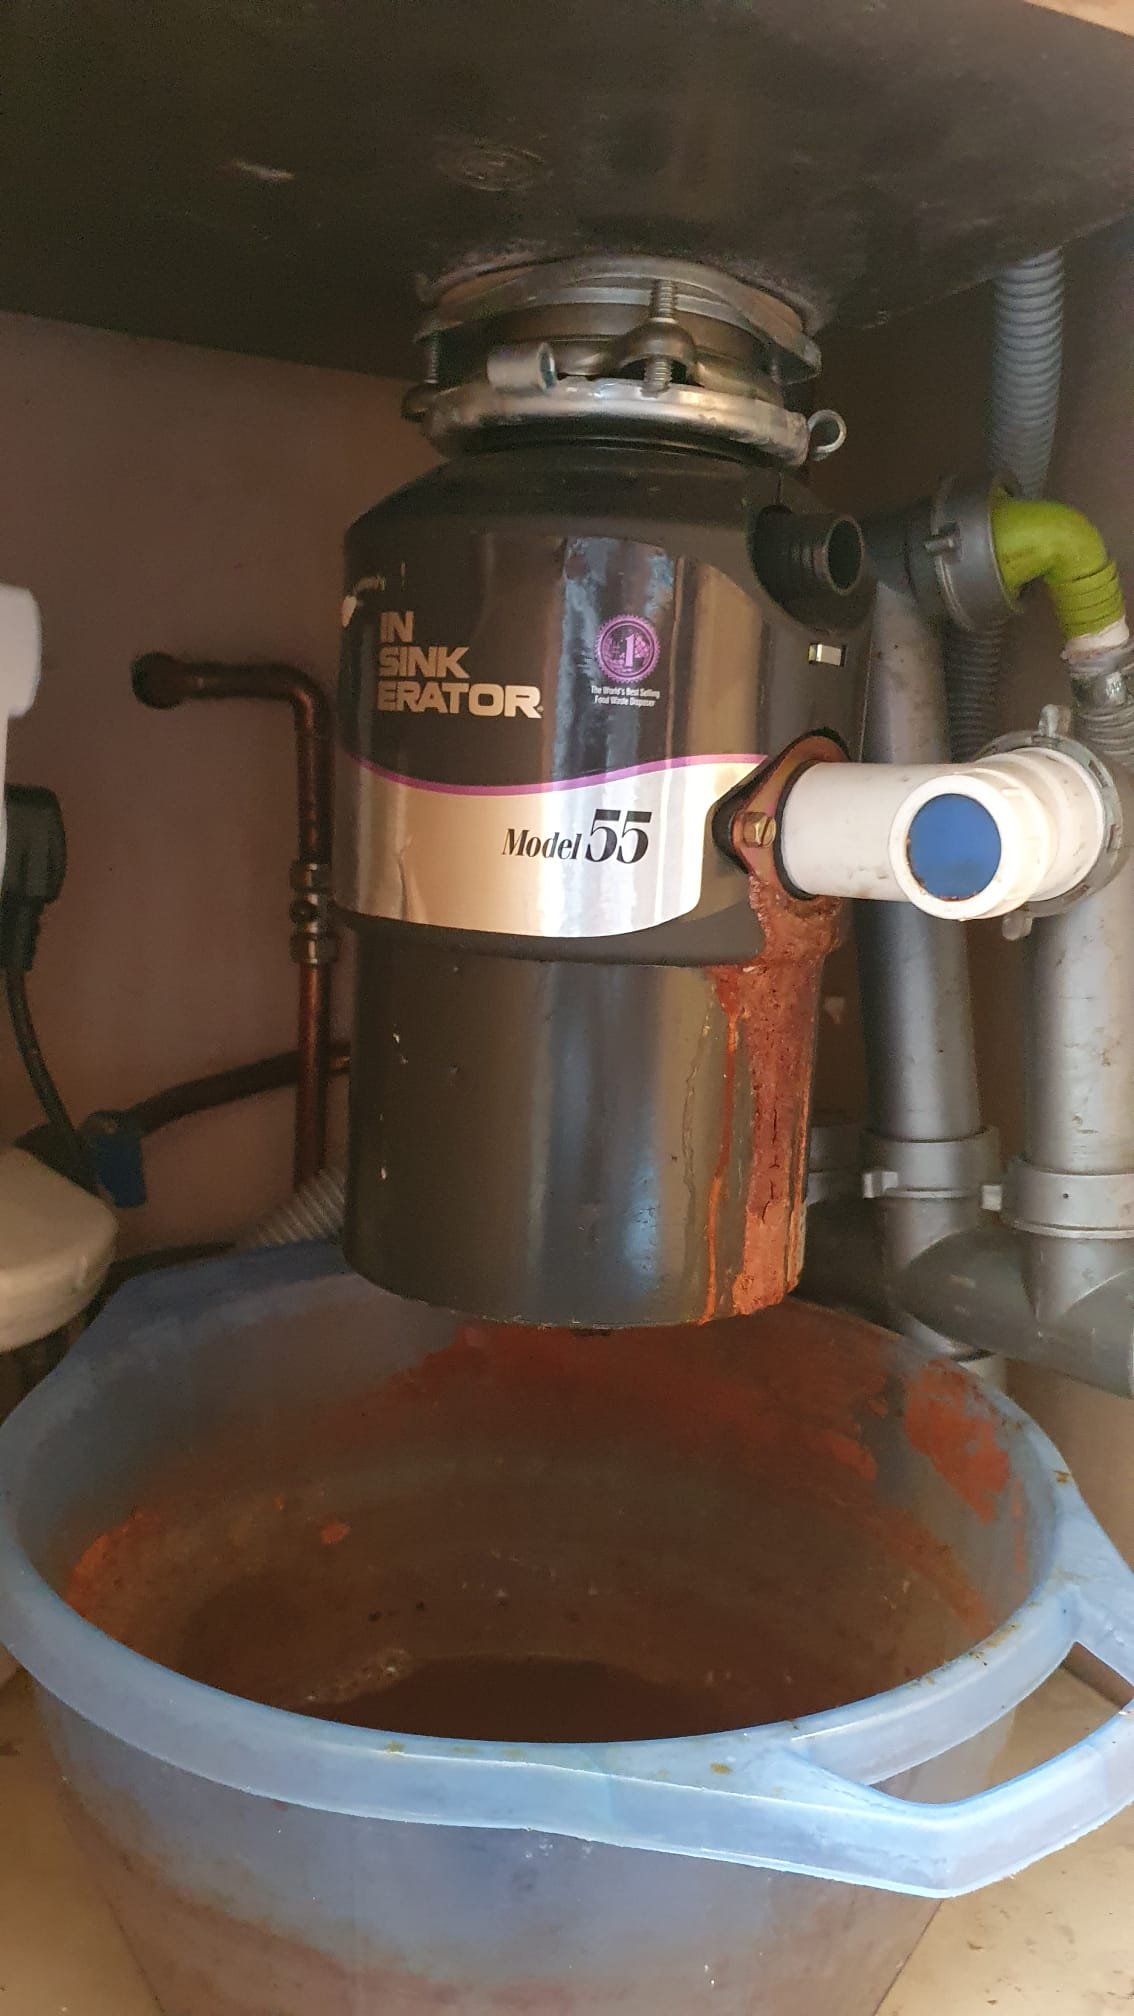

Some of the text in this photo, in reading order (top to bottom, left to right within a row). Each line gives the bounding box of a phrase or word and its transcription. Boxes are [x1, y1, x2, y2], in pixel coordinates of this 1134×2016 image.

[380, 611, 414, 643] IN
[378, 645, 470, 679] SINK
[591, 685, 660, 699] The World's Best Selling
[594, 695, 655, 707] Food Waste Disposer
[502, 809, 653, 864] Model 55
